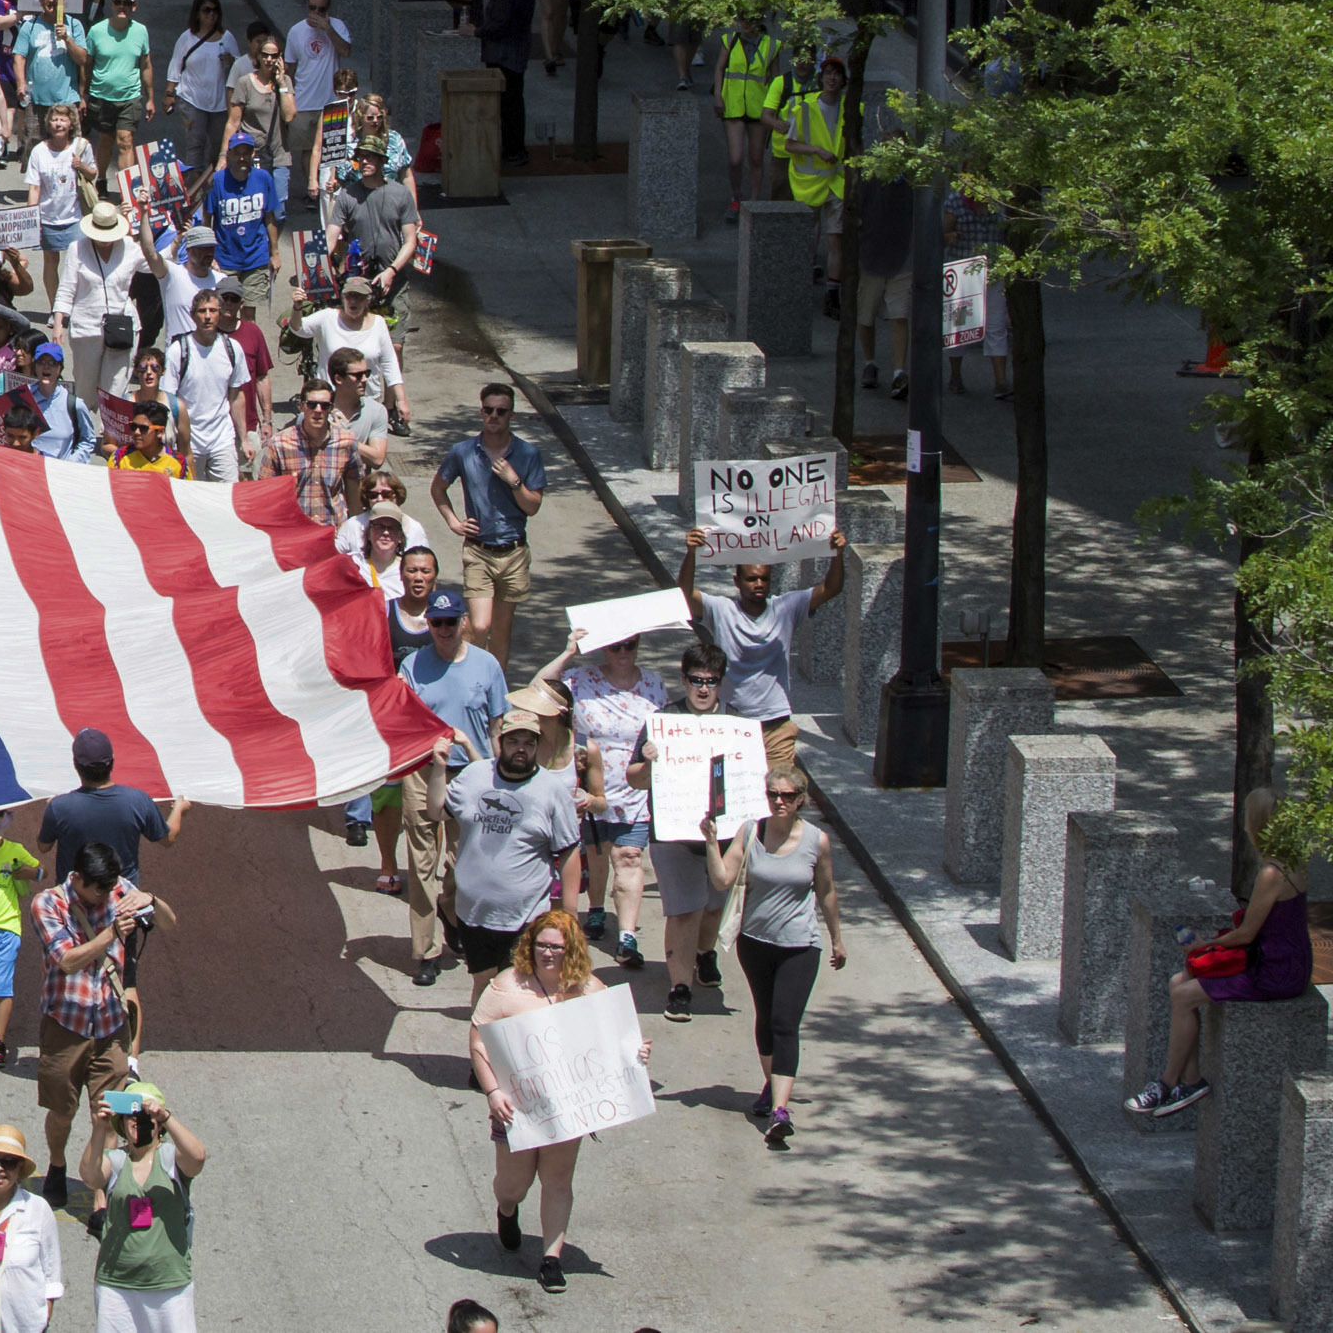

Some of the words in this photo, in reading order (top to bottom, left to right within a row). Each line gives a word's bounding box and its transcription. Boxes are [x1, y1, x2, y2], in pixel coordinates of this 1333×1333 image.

[959, 329, 980, 342] ZONE
[711, 468, 753, 491] NO
[769, 459, 826, 488] ONE
[712, 493, 734, 514] IS
[746, 481, 834, 513] ILLEGAL
[744, 515, 770, 527] ON
[699, 528, 770, 557] STOLEN
[773, 521, 826, 551] LAND
[652, 718, 692, 739] Hate
[700, 722, 724, 735] has
[666, 746, 703, 766] home
[474, 813, 511, 824] Dogfish
[482, 824, 512, 834] Head
[503, 1026, 563, 1072] Las
